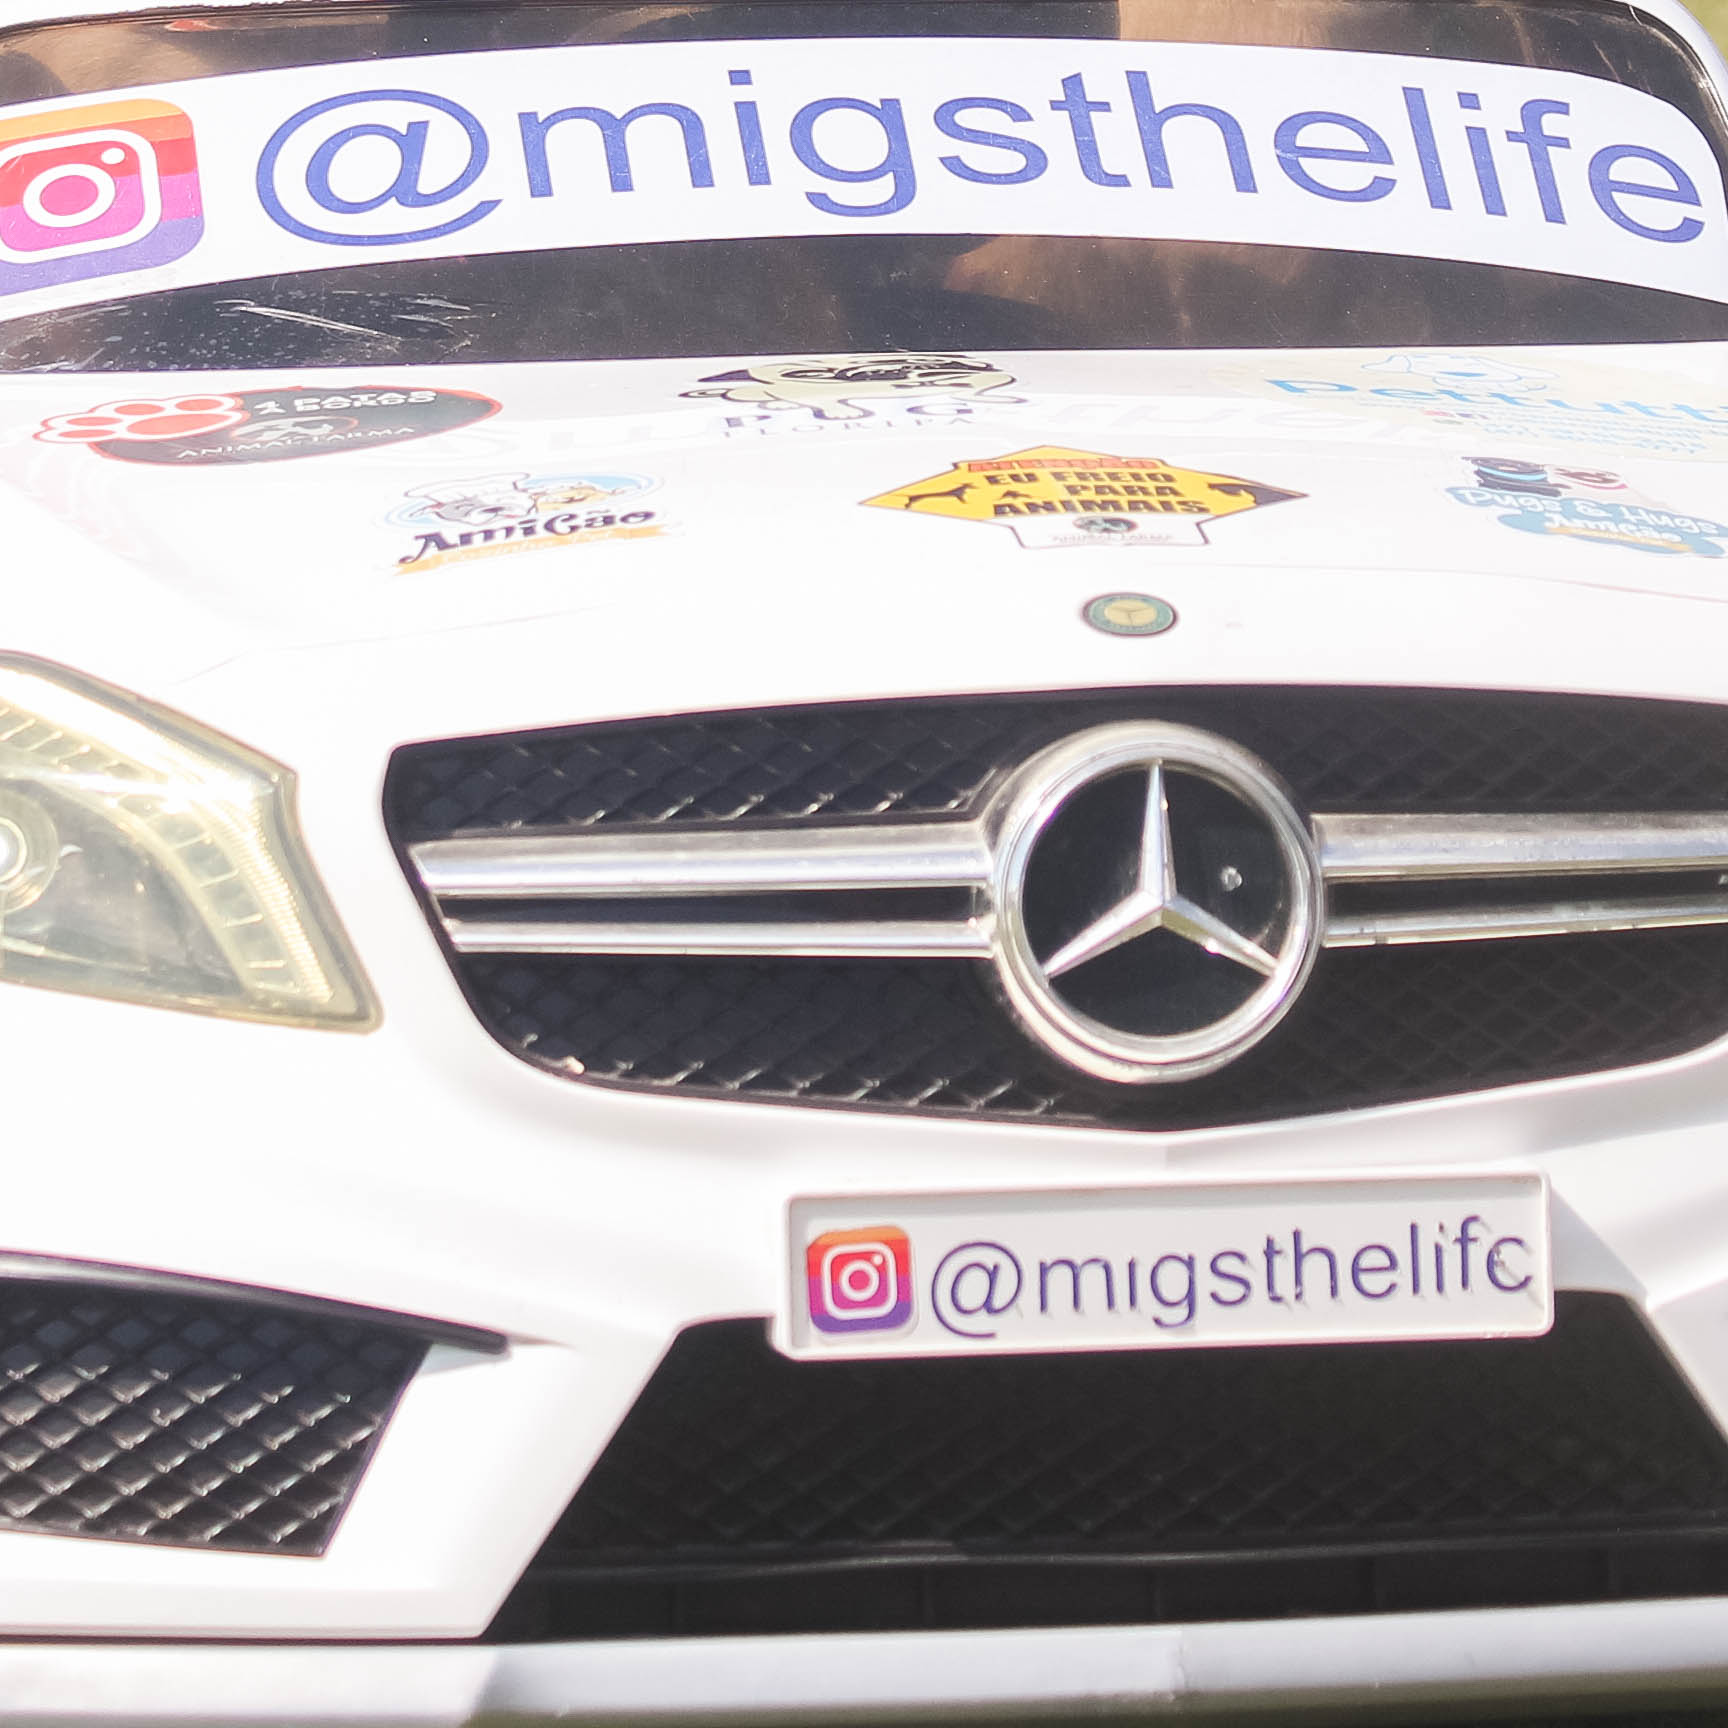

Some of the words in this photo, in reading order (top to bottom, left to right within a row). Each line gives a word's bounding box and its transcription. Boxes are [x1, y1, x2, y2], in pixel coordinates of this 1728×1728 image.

[256, 69, 1705, 247] @migsthelife
[983, 473, 1039, 486] EU
[1049, 471, 1178, 484] FREIO
[1063, 483, 1186, 498] PARA
[993, 499, 1212, 517] ANIMAIS
